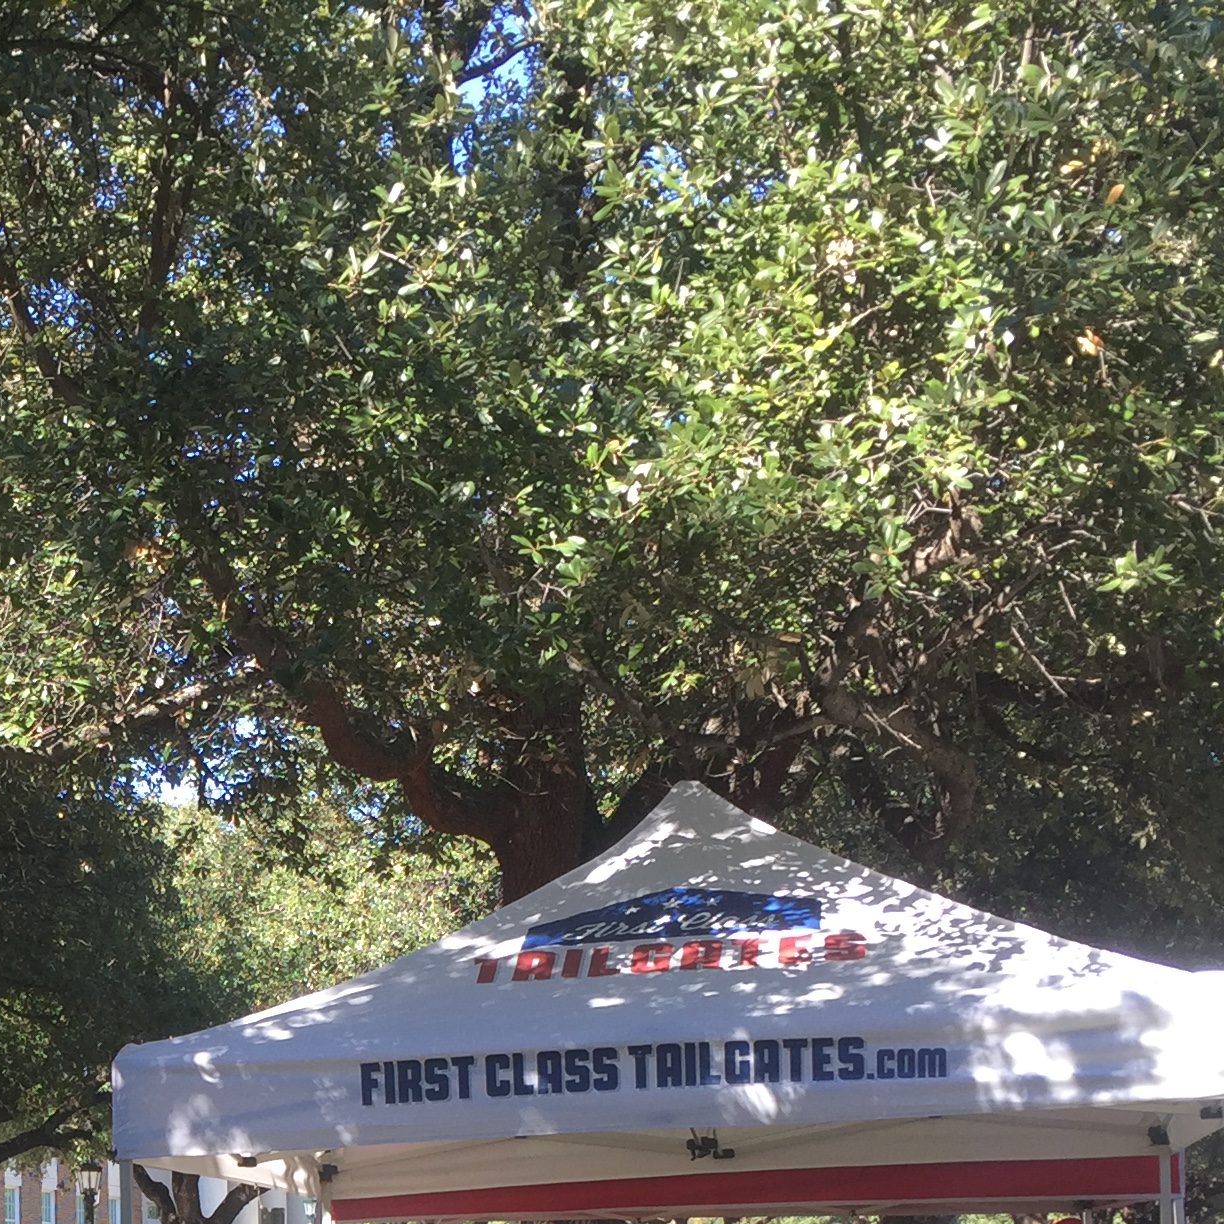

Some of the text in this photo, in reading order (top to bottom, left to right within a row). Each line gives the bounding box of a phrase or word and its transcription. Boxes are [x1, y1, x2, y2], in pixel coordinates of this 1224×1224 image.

[562, 915, 665, 940] First
[475, 932, 867, 984] TAILGATES
[359, 1037, 947, 1106] FIRST CLASS TAILGATES.com
